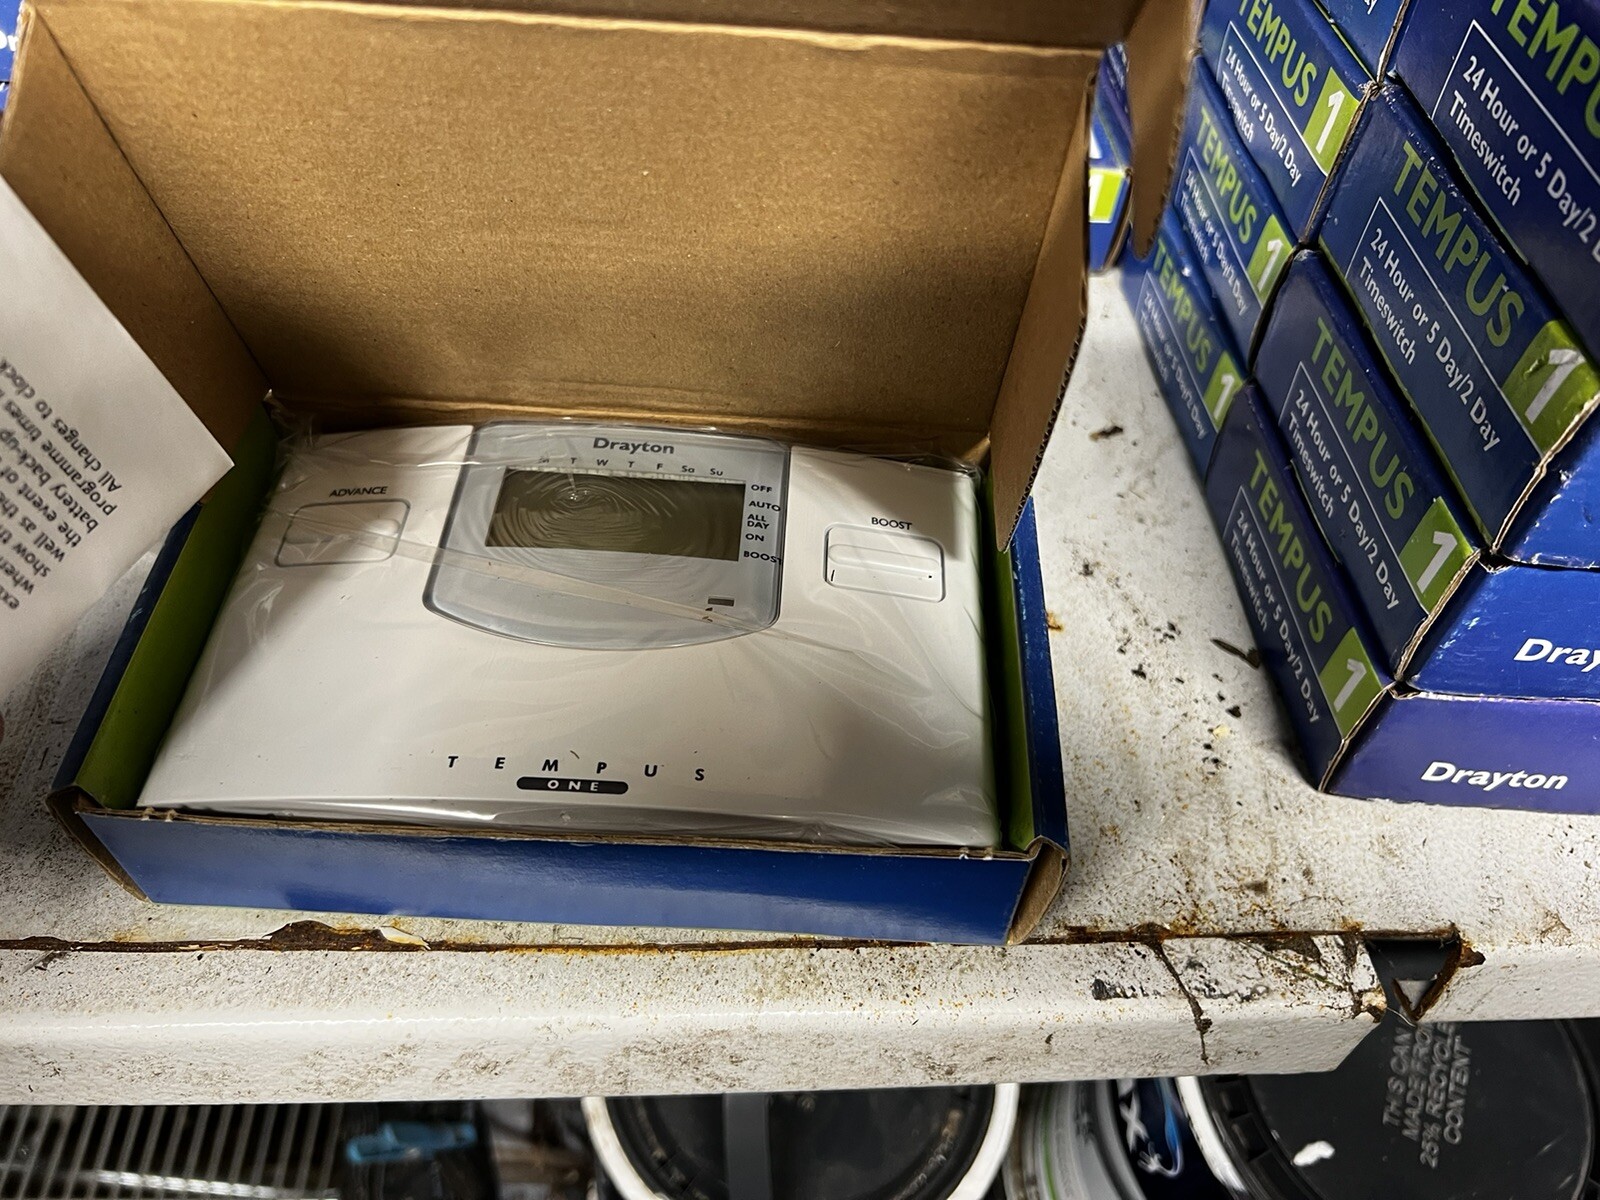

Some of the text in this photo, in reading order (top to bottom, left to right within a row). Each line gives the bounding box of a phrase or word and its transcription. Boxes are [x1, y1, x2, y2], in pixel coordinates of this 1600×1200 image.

[1225, 46, 1302, 187] 24 Hour or 5 Day/2 Day
[1315, 90, 1345, 155] 1
[1448, 89, 1522, 207] Timeswitch
[1462, 55, 1597, 244] 24 Hour or 5 Day/2
[1191, 187, 1208, 222] Hour
[1196, 105, 1284, 292] TEMPUS 1
[1180, 190, 1209, 264] Timeswitch
[1205, 218, 1215, 236] or
[1211, 230, 1220, 247] 5
[1215, 243, 1236, 288] Day/2
[1393, 139, 1587, 425] TEMPUS 1
[1232, 279, 1248, 316] Day
[1359, 256, 1418, 366] Timeswitch
[1153, 236, 1235, 420] TEMPUS 1
[1370, 228, 1501, 452] 24 Hour or 5 Day/2 Day
[36, 400, 52, 419] to
[1190, 405, 1209, 441] Day
[5, 401, 118, 516] programme times
[52, 418, 101, 472] changes
[570, 457, 578, 465] T
[596, 458, 609, 467] W
[628, 461, 635, 469] T
[656, 462, 664, 470] F
[681, 465, 695, 474] Sa
[710, 467, 723, 477] Su
[593, 437, 675, 454] Drayton
[1287, 411, 1335, 519] Timeswitch
[1310, 316, 1459, 595] TEMPUS 1
[0, 429, 99, 534] battery back-up
[100, 470, 122, 493] All
[329, 486, 388, 498] ADVANCE
[751, 484, 773, 494] OFF
[1295, 389, 1399, 610] 24 Hour or 5 Day/2 Day
[0, 466, 82, 548] the event of
[19, 516, 37, 533] as
[747, 513, 767, 522] ALL
[747, 520, 770, 530] DAY
[748, 500, 781, 512] AUTO
[871, 516, 913, 531] BOOST
[12, 542, 51, 577] show
[33, 531, 65, 562] well
[745, 533, 765, 542] ON
[1230, 530, 1268, 632] Timeswitch
[1250, 449, 1367, 713] TEMPUS 1
[1236, 510, 1320, 724] 24 Hour or 5 Day/2 Day
[447, 755, 706, 782] TEMPUS
[547, 779, 600, 792] ONE
[1420, 761, 1569, 791] Drayton
[1382, 1027, 1412, 1127] THIS CAN
[1443, 1035, 1472, 1144] CONTENT
[1402, 1073, 1427, 1142] MADE
[1419, 1121, 1442, 1169] 25%
